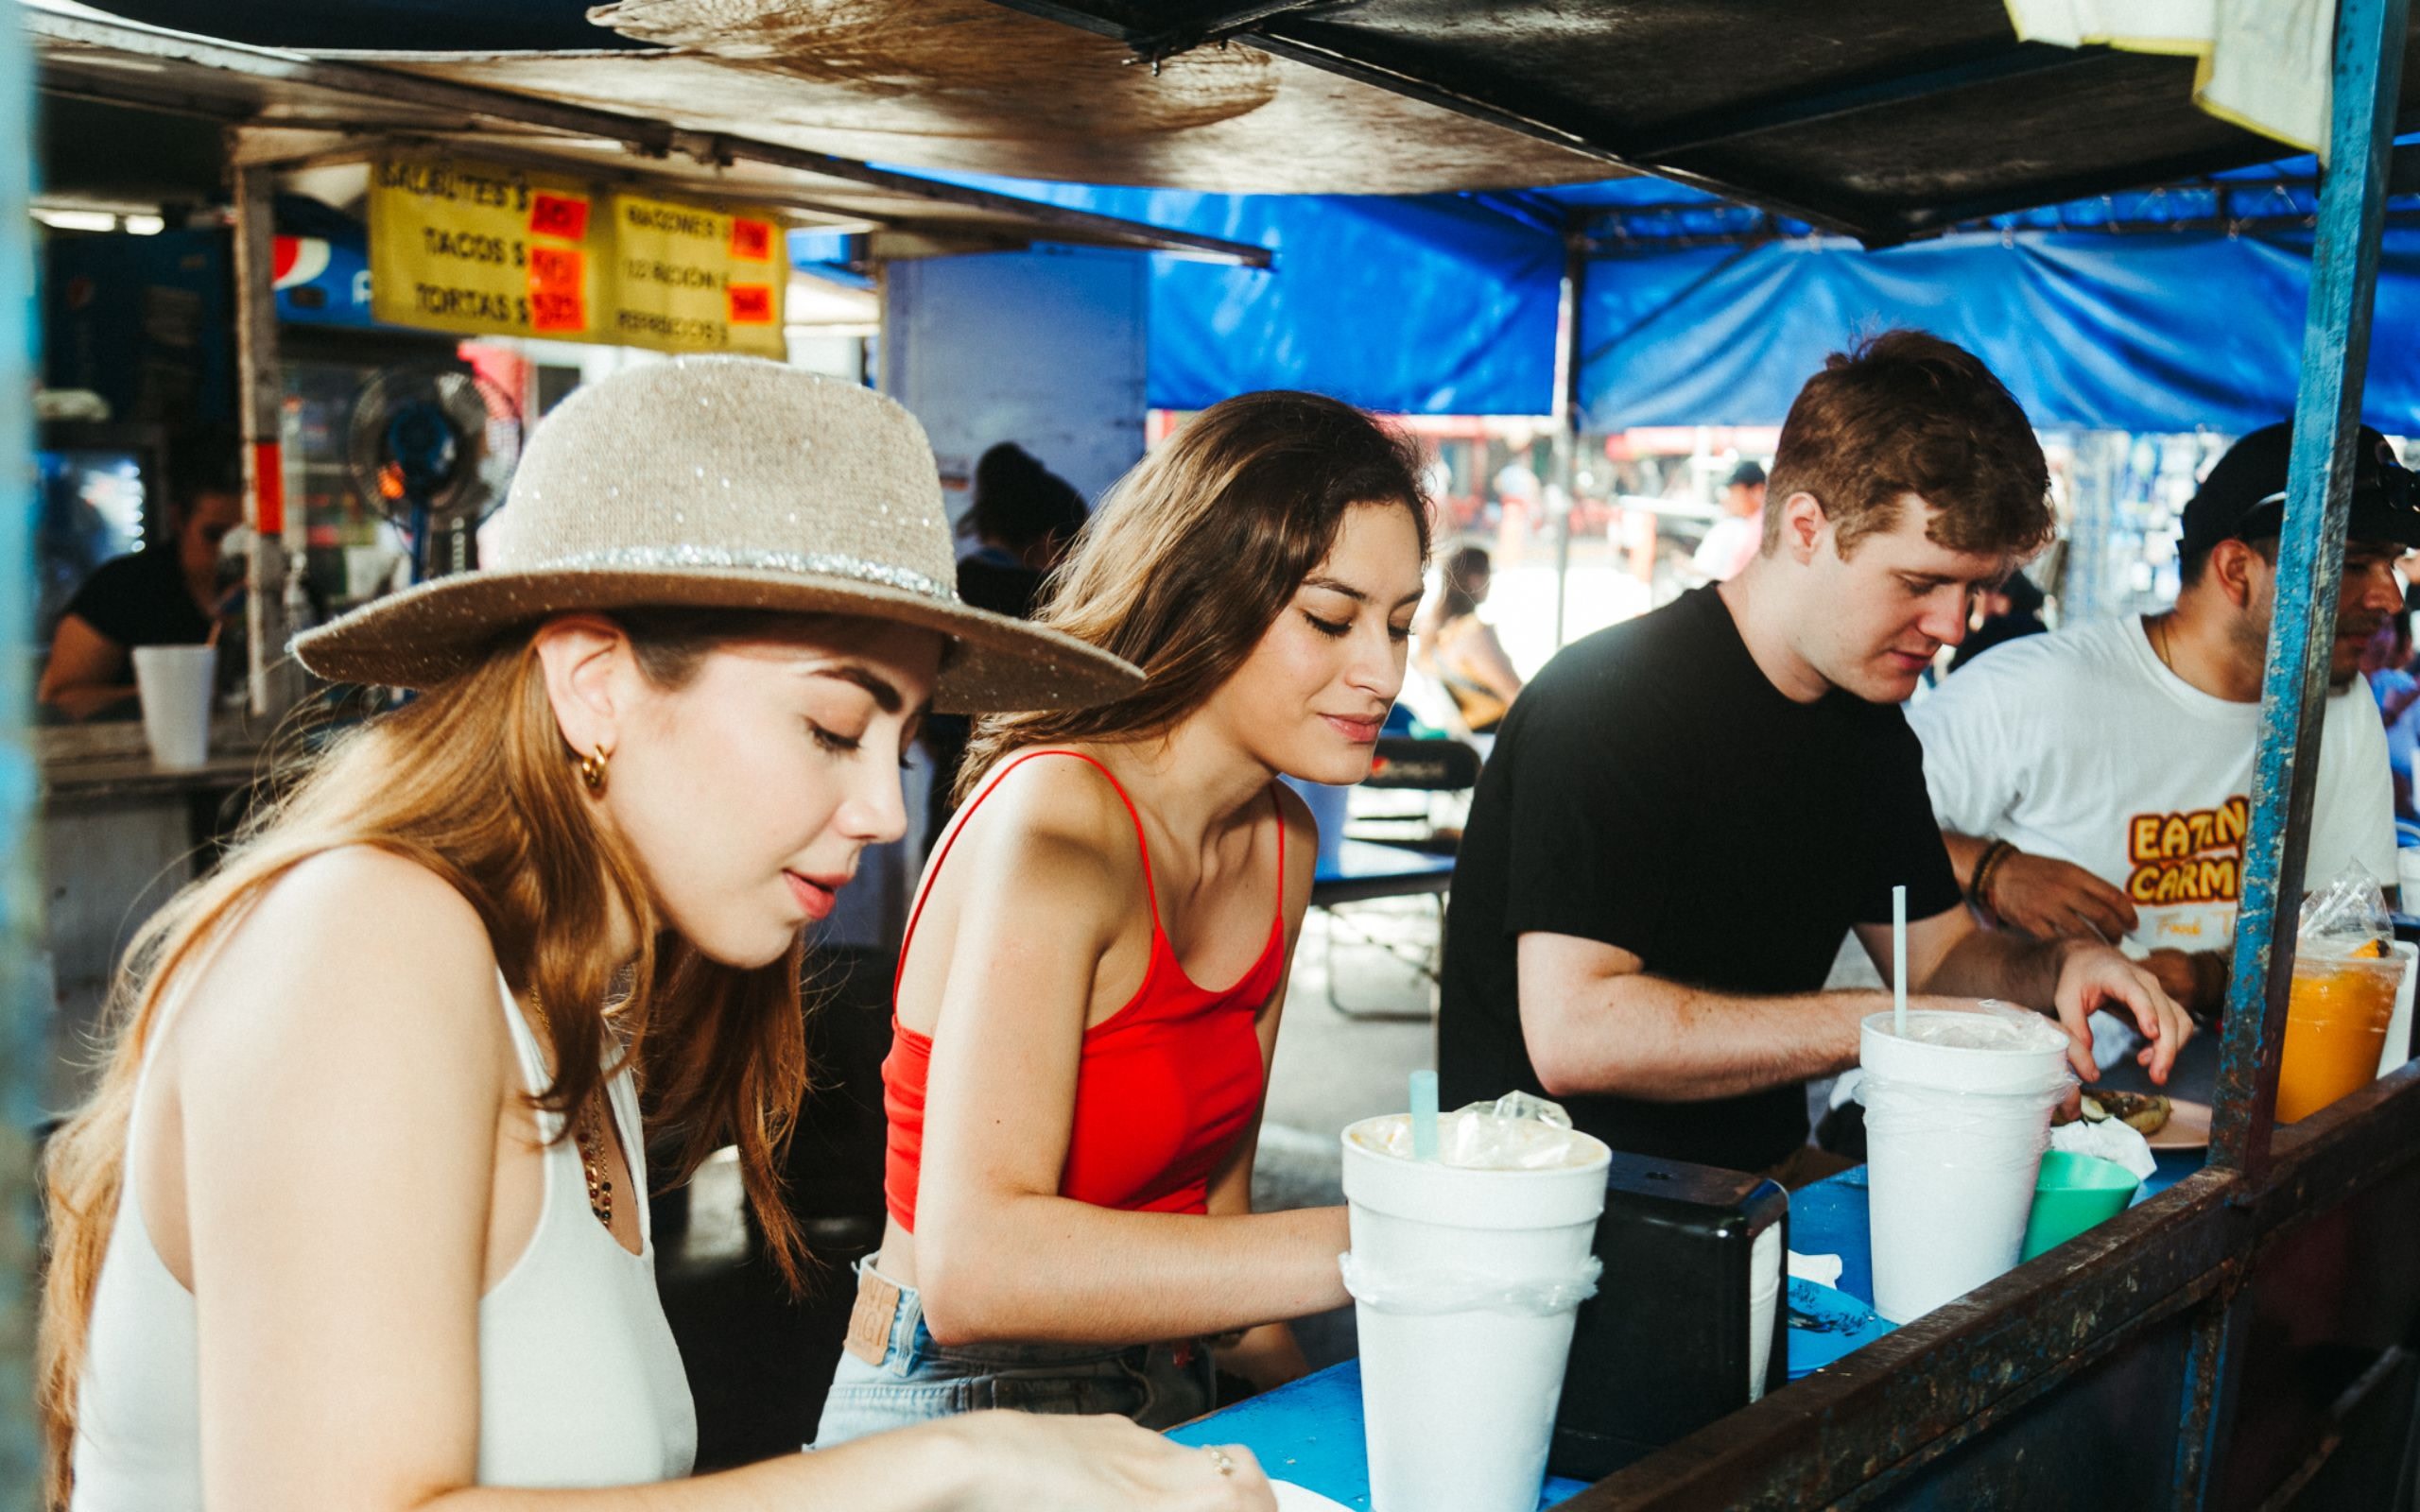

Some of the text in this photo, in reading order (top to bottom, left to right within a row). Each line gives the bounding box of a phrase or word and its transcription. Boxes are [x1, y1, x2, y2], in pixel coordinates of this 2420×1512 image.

[422, 225, 508, 266] TACOS
[414, 282, 511, 323] TORTAS
[2130, 795, 2248, 865] EATIN
[2125, 858, 2240, 905] CARM
